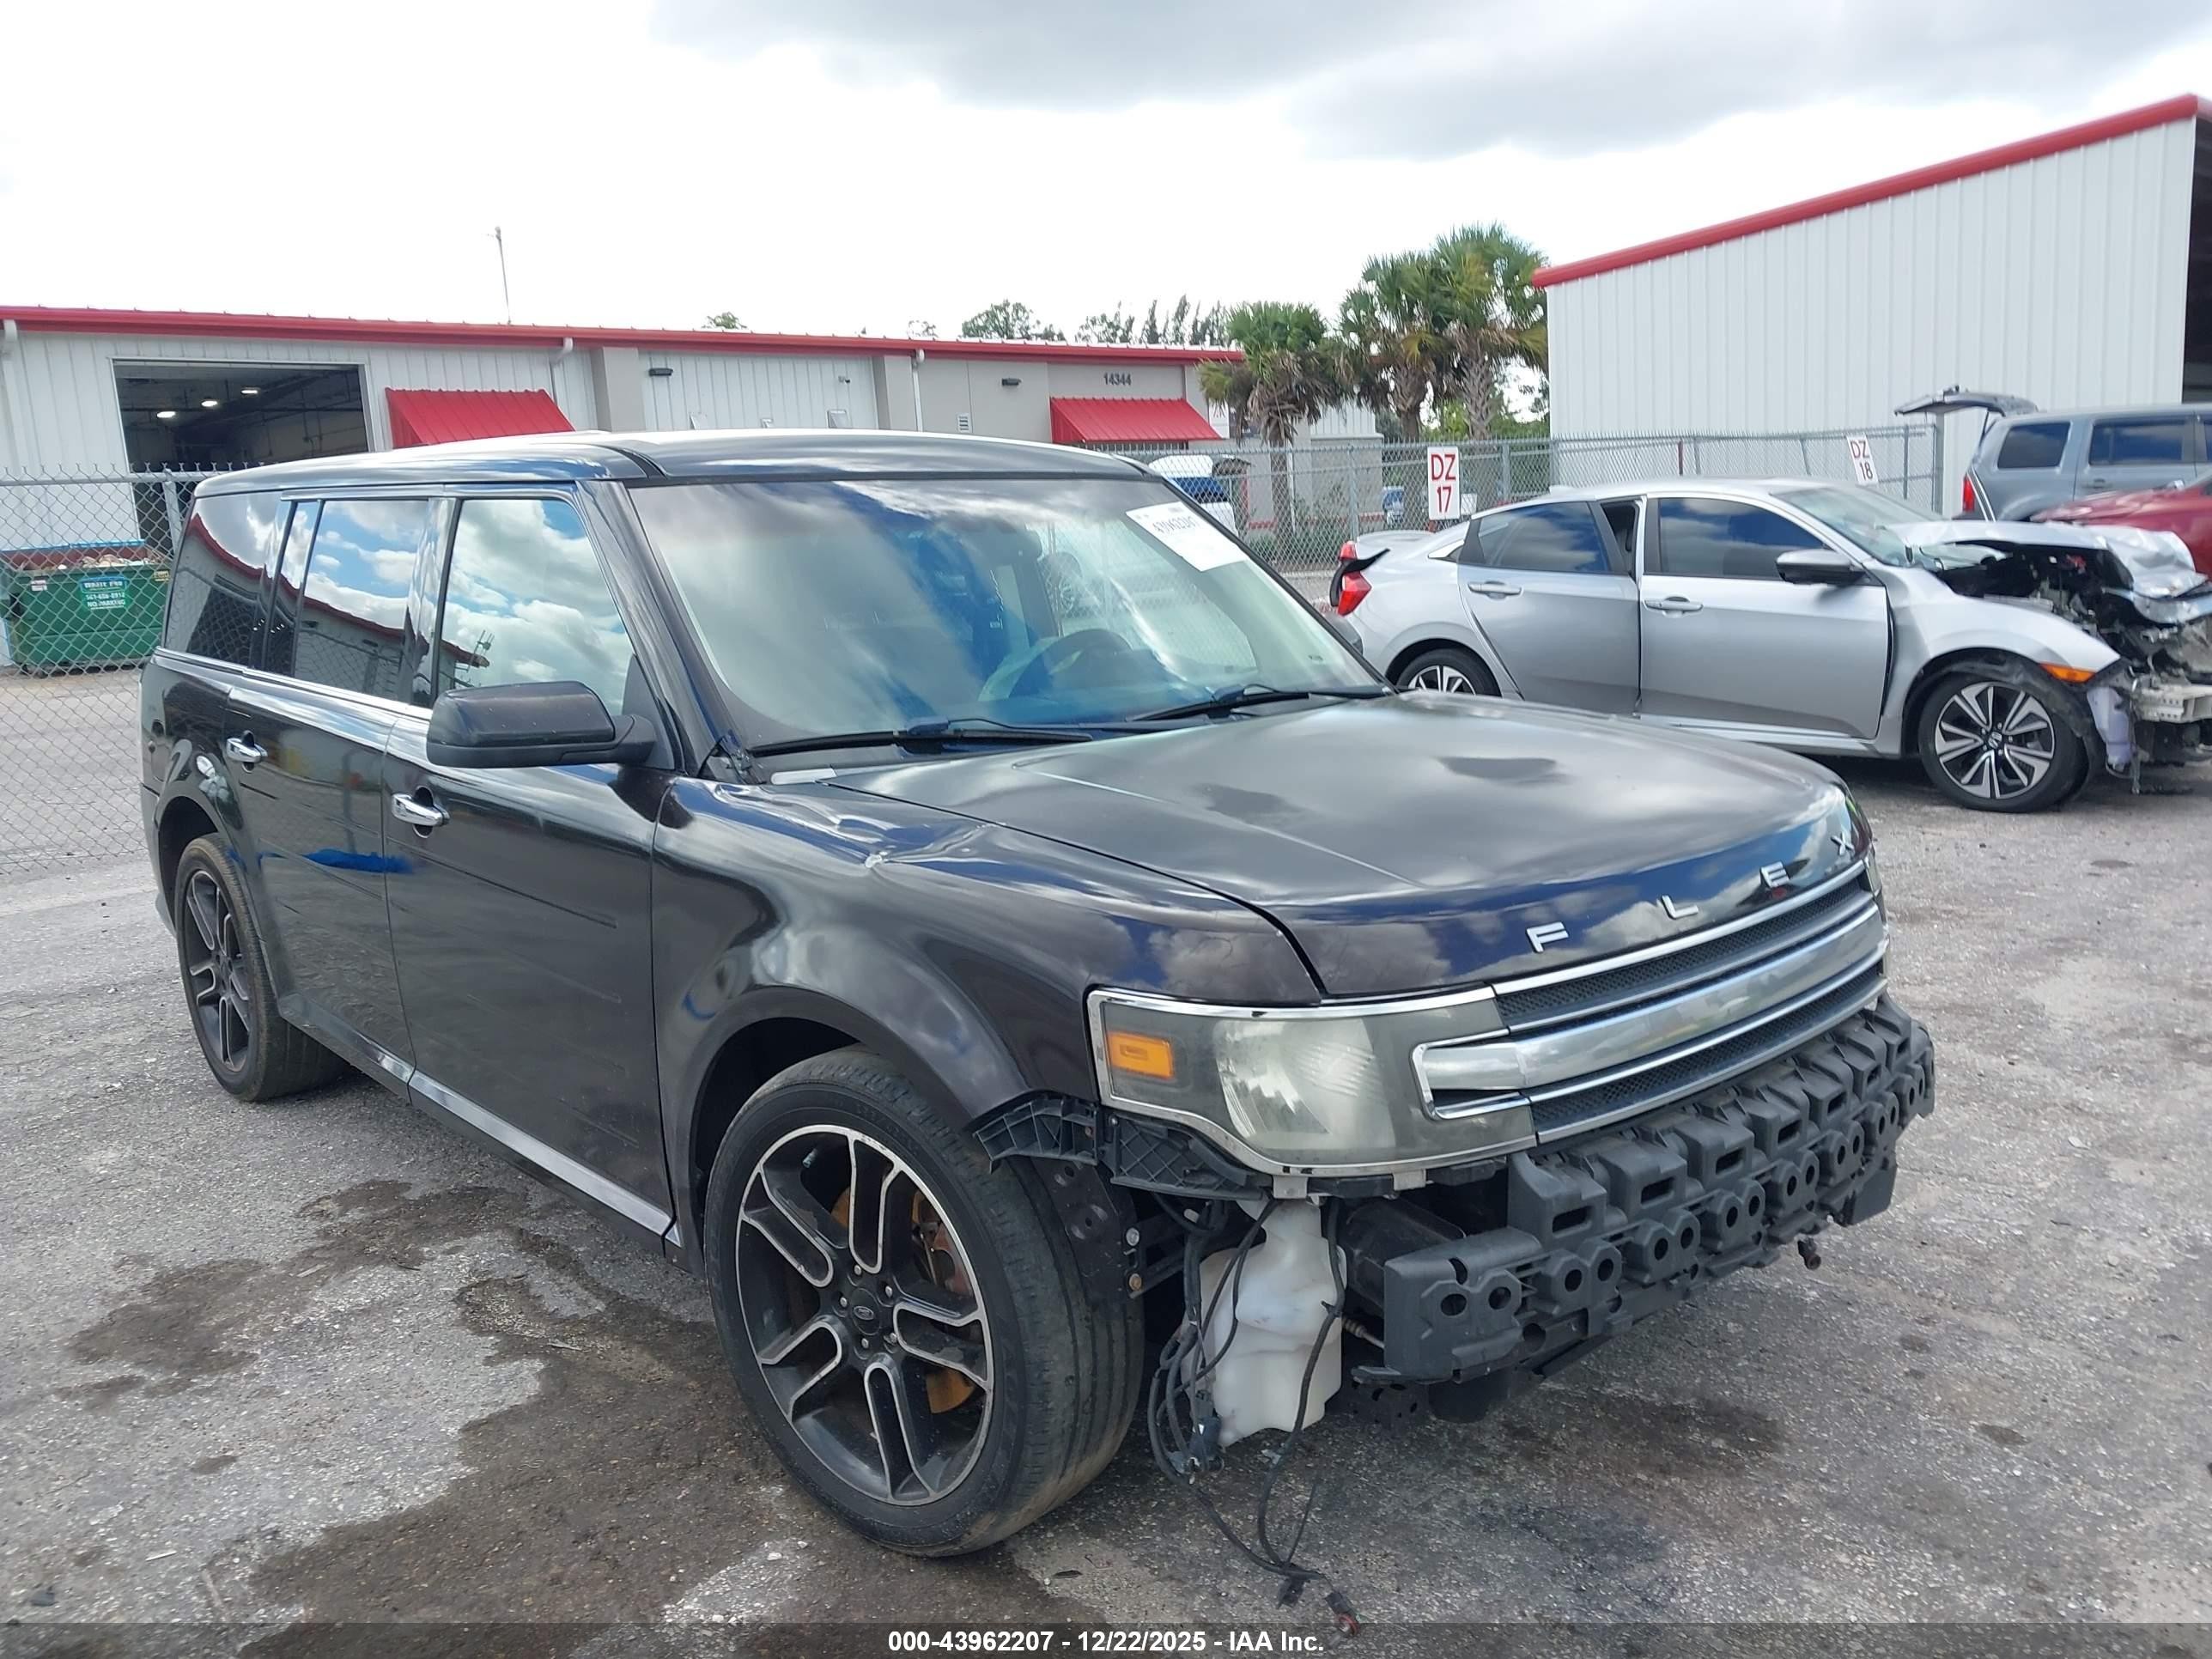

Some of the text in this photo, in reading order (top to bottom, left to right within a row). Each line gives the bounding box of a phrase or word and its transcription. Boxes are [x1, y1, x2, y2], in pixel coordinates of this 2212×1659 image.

[1103, 372, 1132, 386] 14344
[1850, 440, 1870, 459] DZ
[1431, 453, 1456, 481] DZ
[1859, 461, 1874, 481] 18
[1437, 485, 1452, 514] 17
